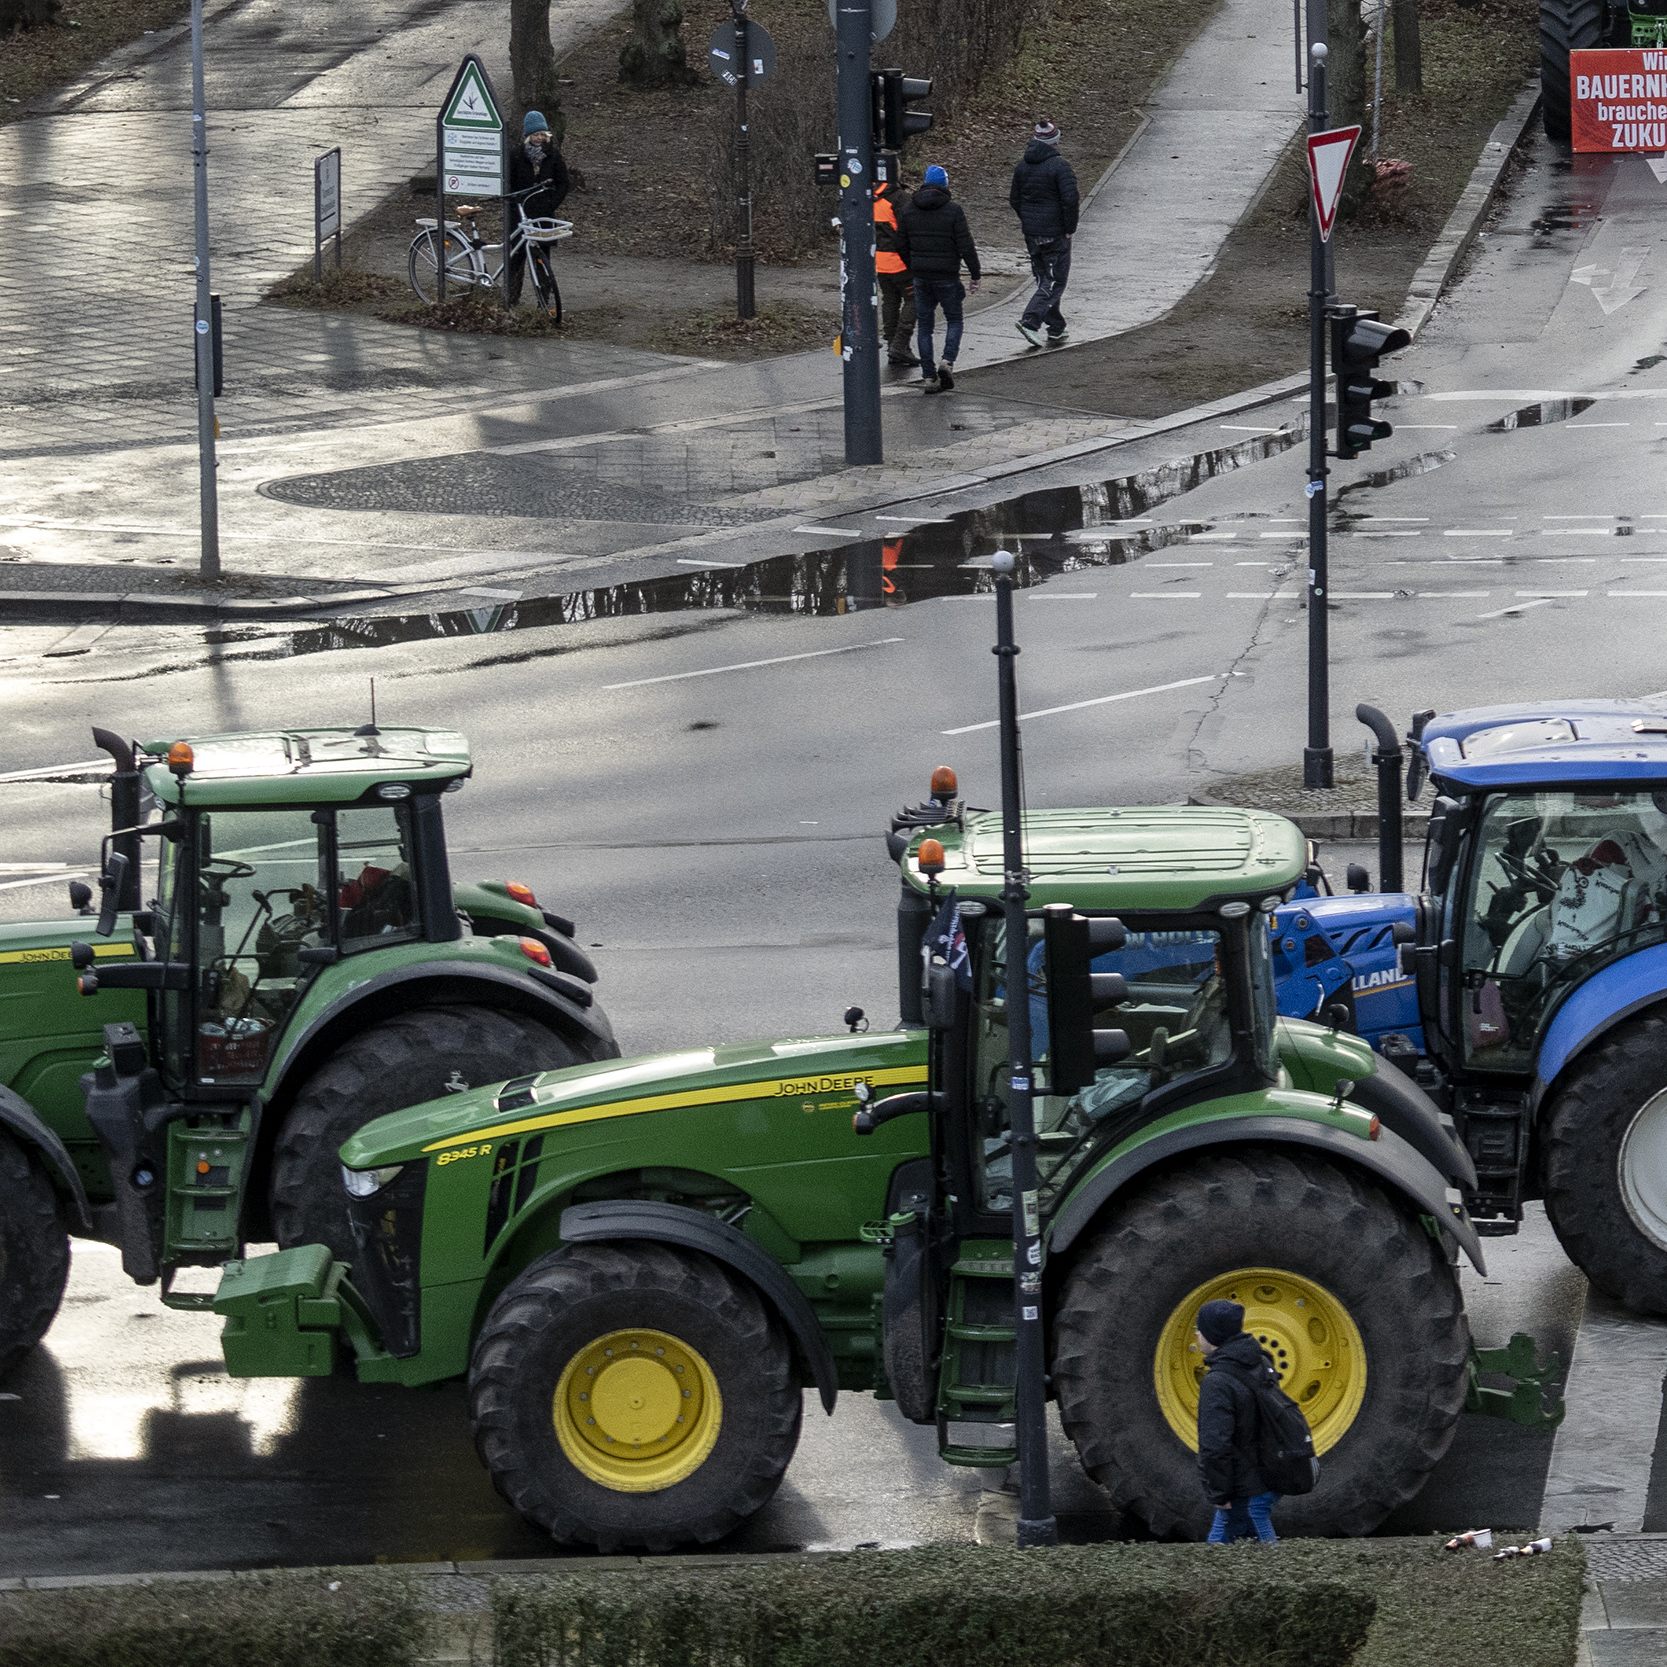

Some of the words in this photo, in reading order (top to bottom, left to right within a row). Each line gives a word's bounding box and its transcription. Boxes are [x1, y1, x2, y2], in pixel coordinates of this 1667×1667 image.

[20, 952, 49, 963] JOHN
[774, 1079, 818, 1097] JOHN
[437, 1146, 478, 1166] 8345
[479, 1144, 492, 1156] R
